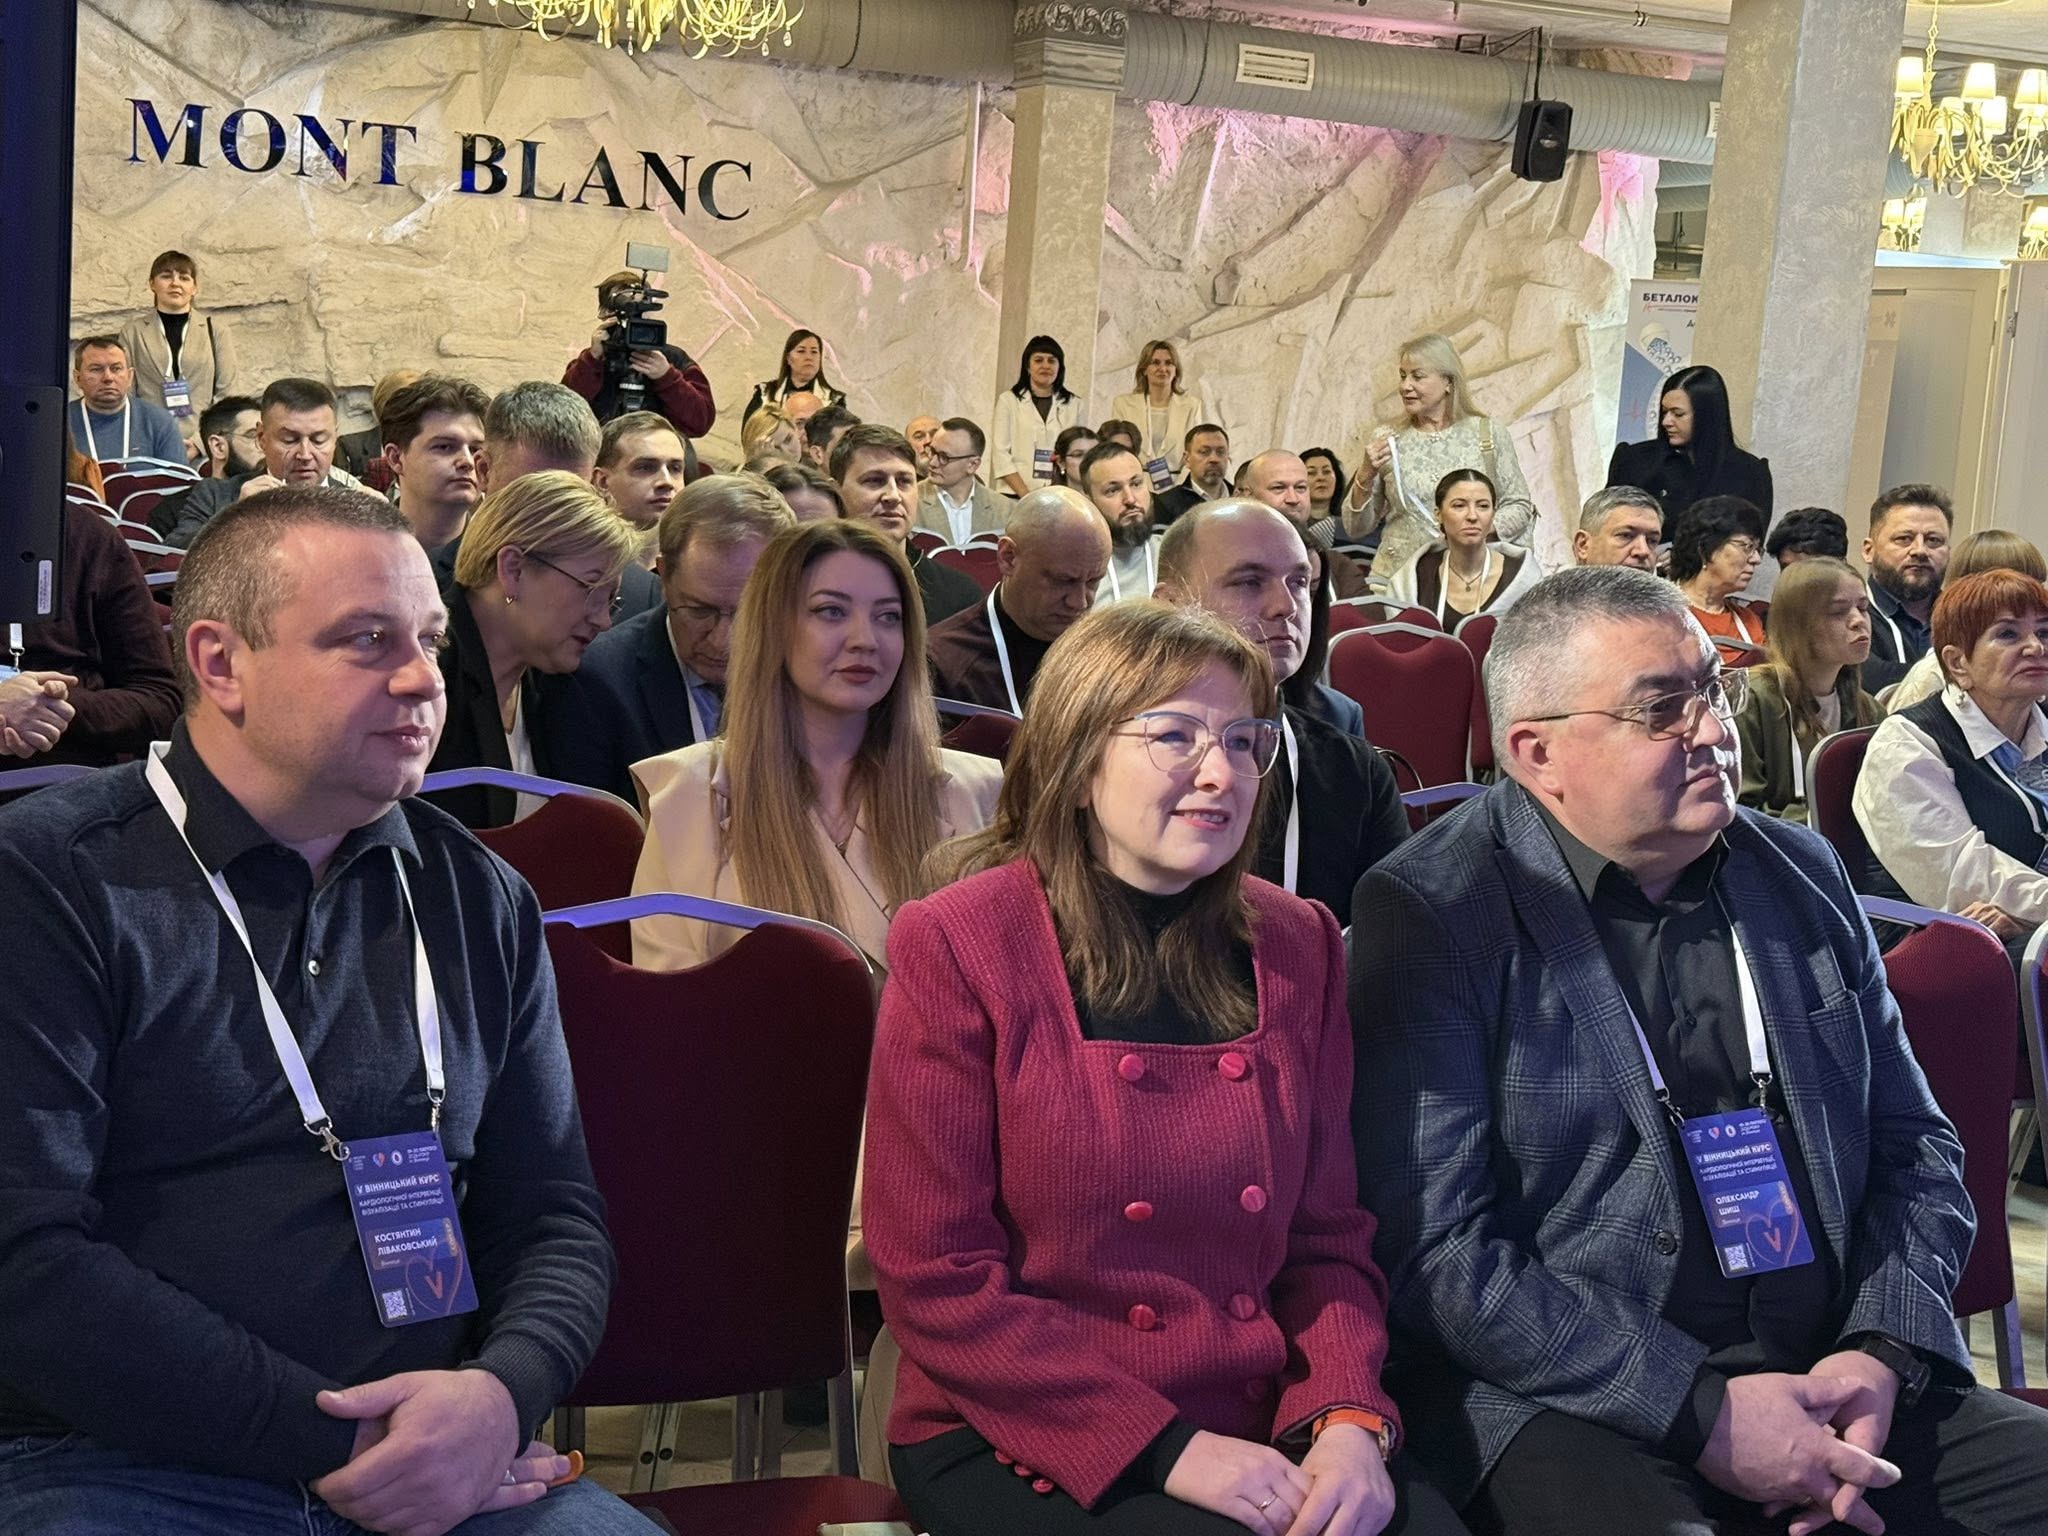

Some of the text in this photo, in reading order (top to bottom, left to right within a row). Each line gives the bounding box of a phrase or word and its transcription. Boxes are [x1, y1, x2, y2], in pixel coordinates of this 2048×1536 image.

[125, 98, 753, 221] MONT BLANC
[1643, 292, 1698, 304] БЕТАЛОК
[1703, 1145, 1752, 1162] ВІННИЦЬКИЙ
[1752, 1143, 1772, 1155] КУРС
[364, 1176, 418, 1193] ВІННИЦЬКИЙ
[419, 1174, 440, 1186] КУРС
[1715, 1190, 1760, 1205] ОЛЕКСАНДР
[1718, 1205, 1740, 1216] ШИШ
[374, 1227, 422, 1243] КОСТЯНТИН
[378, 1235, 438, 1257] ЛІВАКОВСЬКИЙ
